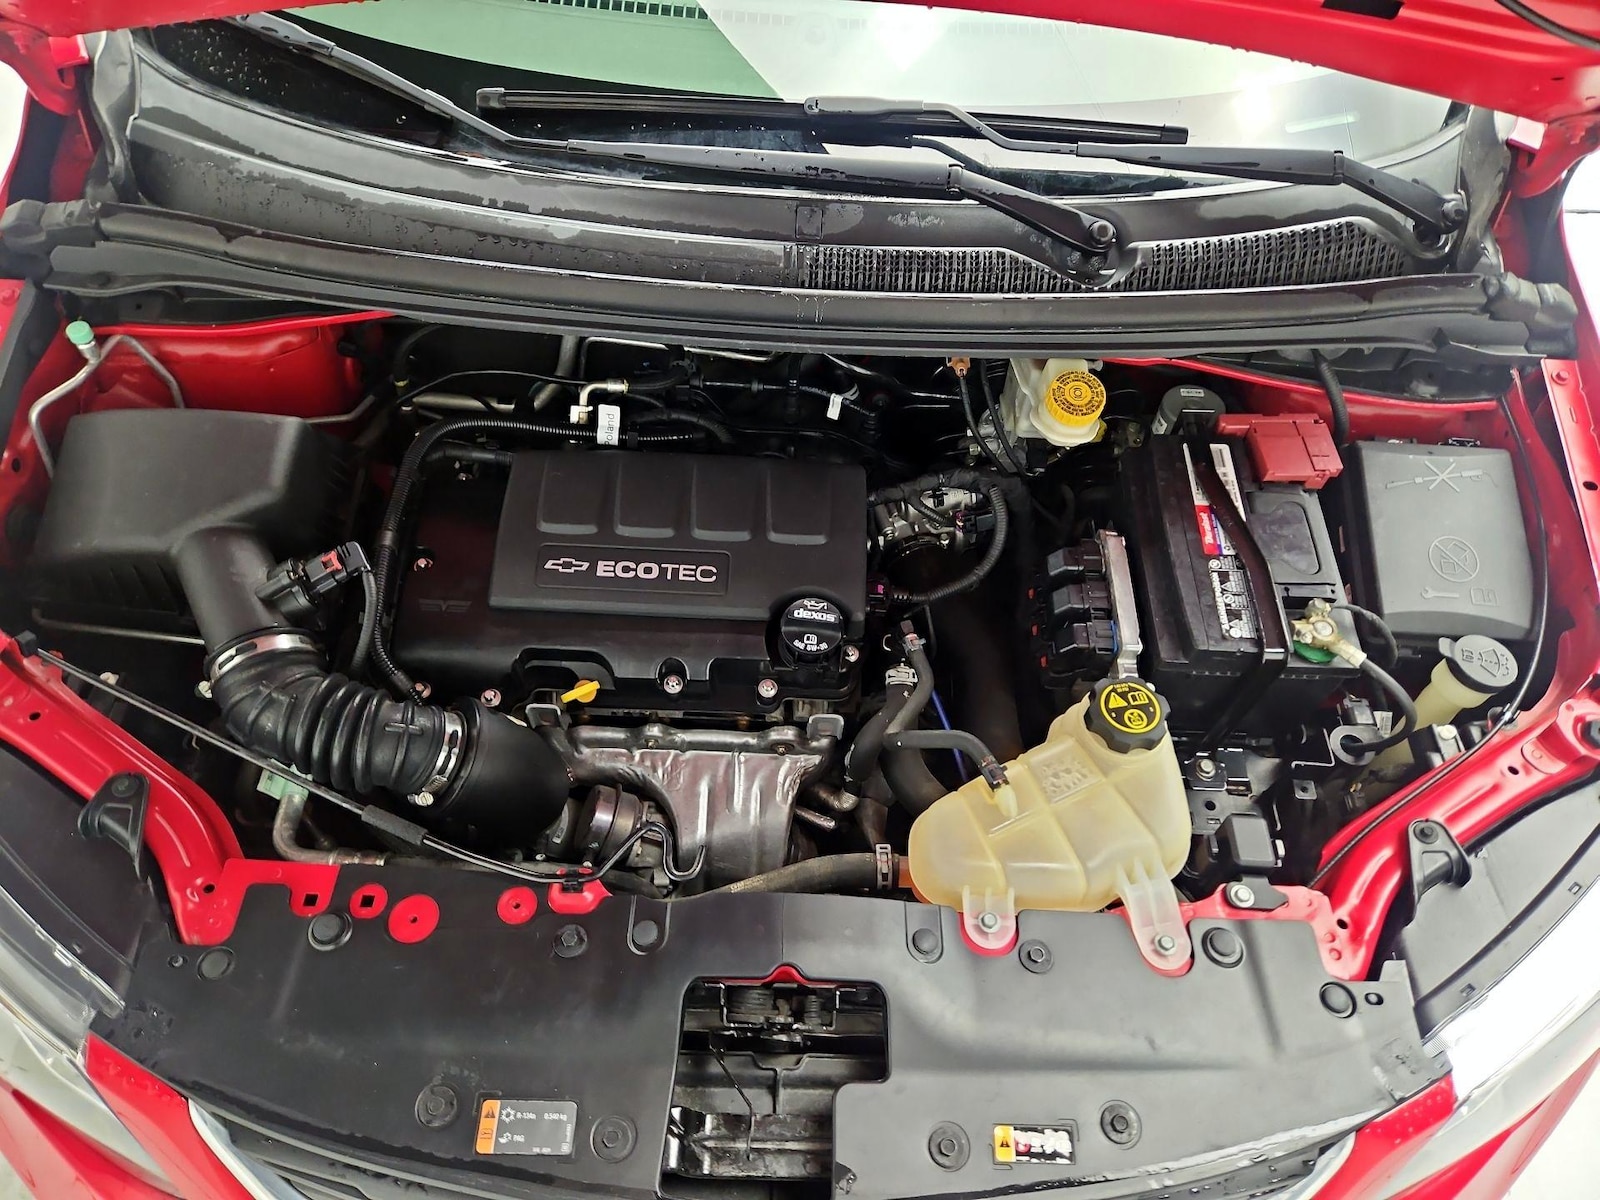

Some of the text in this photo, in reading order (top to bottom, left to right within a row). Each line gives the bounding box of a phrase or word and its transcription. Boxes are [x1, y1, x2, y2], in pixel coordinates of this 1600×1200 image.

[604, 413, 615, 445] Poland
[596, 560, 718, 583] ECOTEC
[794, 608, 836, 622] dexos
